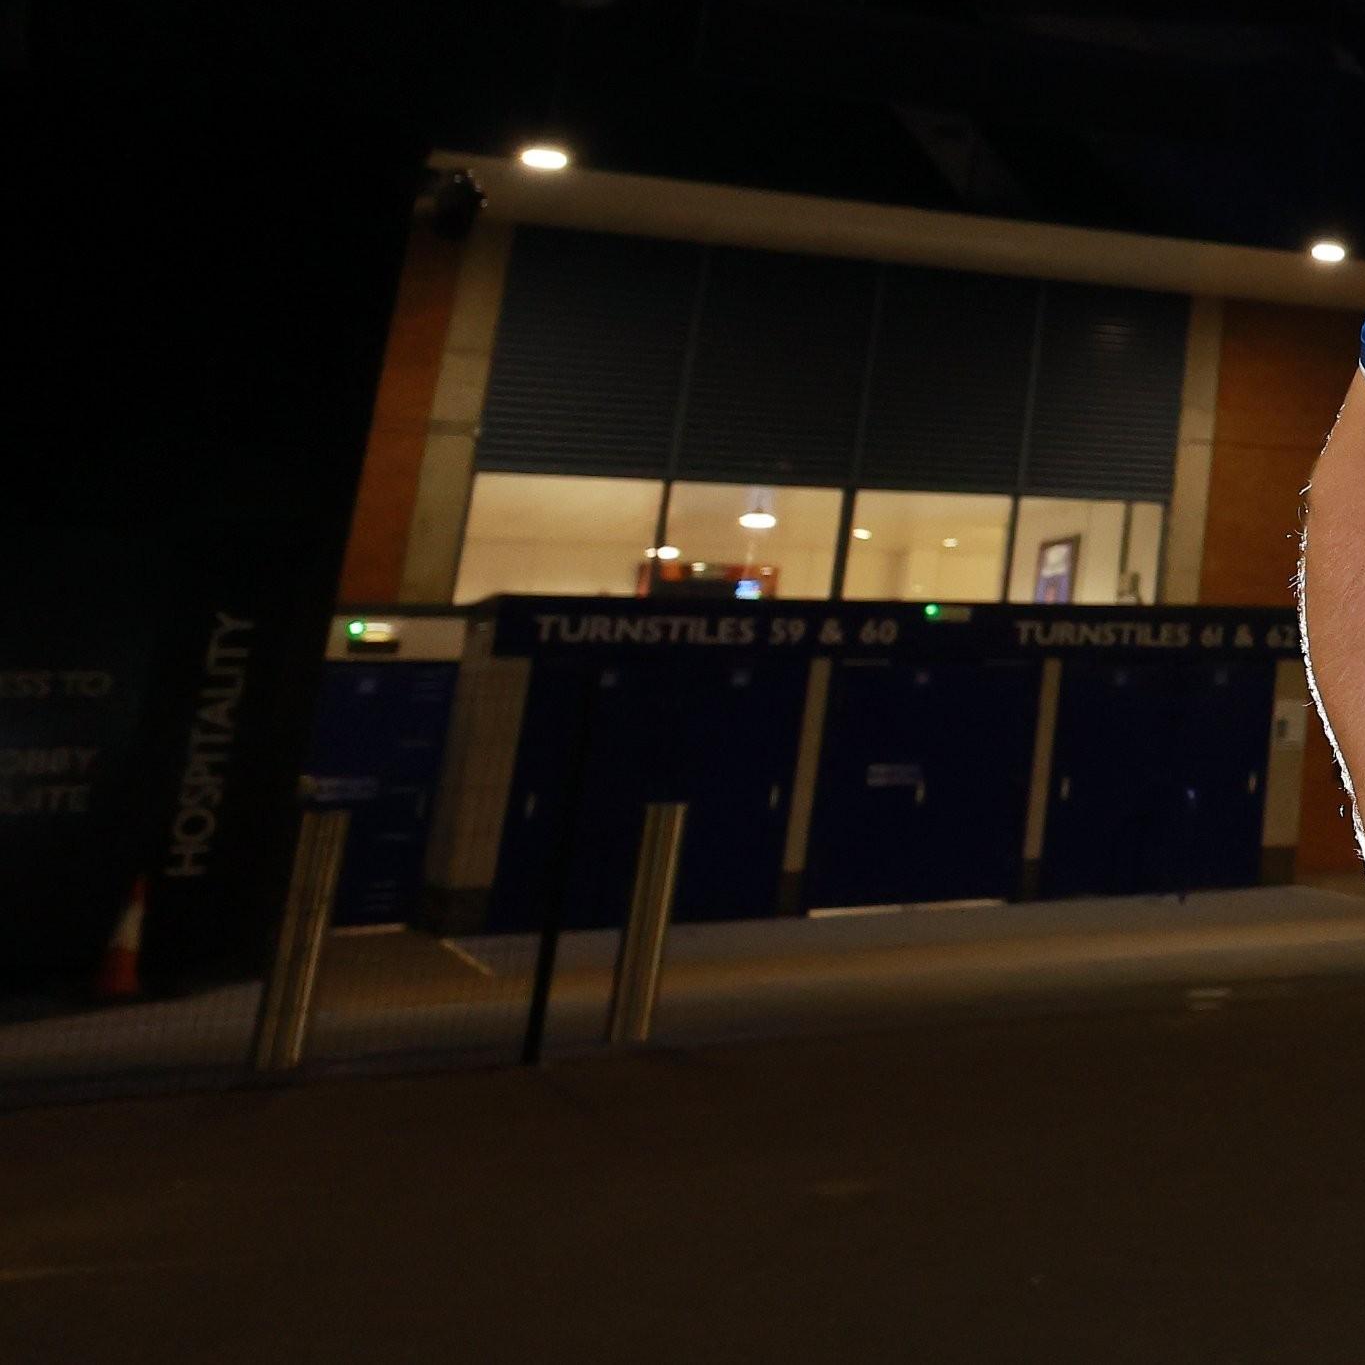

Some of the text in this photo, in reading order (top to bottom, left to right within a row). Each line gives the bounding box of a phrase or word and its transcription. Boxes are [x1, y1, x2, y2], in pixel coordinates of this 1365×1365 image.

[534, 614, 900, 646] TURNSTILES 59 & 60
[1014, 619, 1191, 648] TURNSTILES
[163, 609, 257, 880] HOSPITALITY
